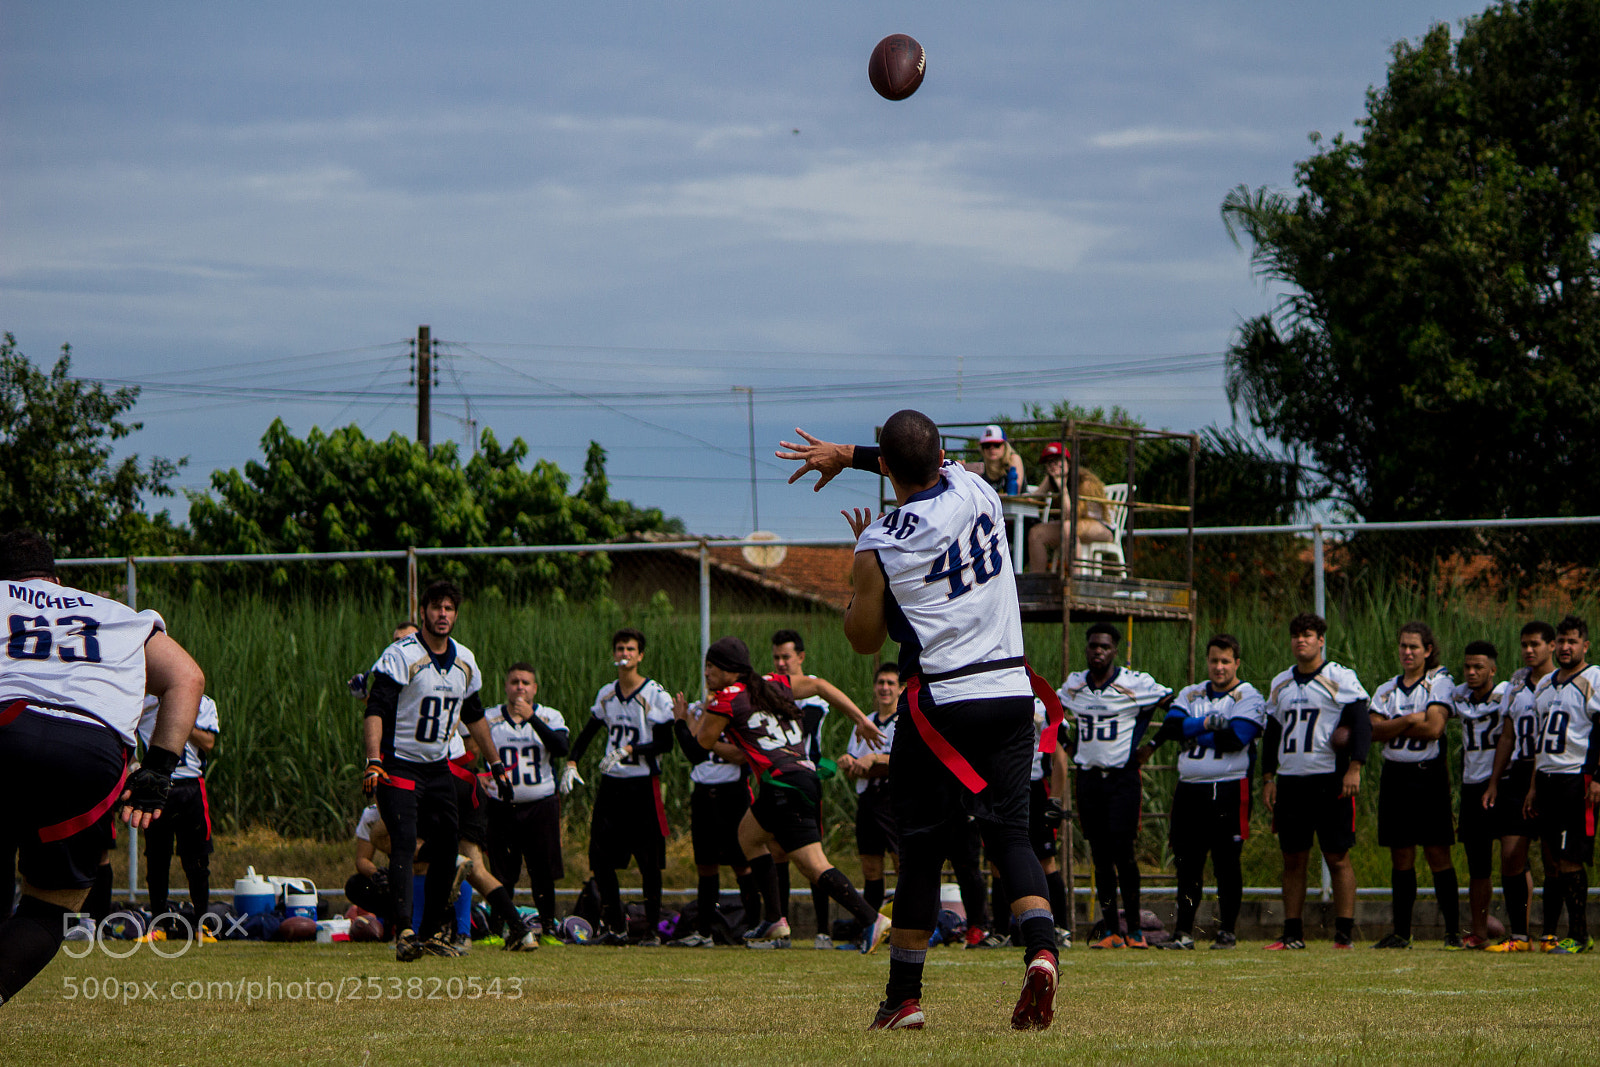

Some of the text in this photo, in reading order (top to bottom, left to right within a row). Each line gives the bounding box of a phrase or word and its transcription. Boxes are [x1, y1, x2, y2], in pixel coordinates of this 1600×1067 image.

[882, 508, 919, 540] 46
[923, 511, 1003, 600] 46
[8, 584, 93, 609] MICHEL
[6, 613, 102, 664] 63
[415, 695, 459, 743] 87
[1282, 708, 1320, 754] 27
[1463, 711, 1502, 752] 12
[499, 745, 541, 787] 93
